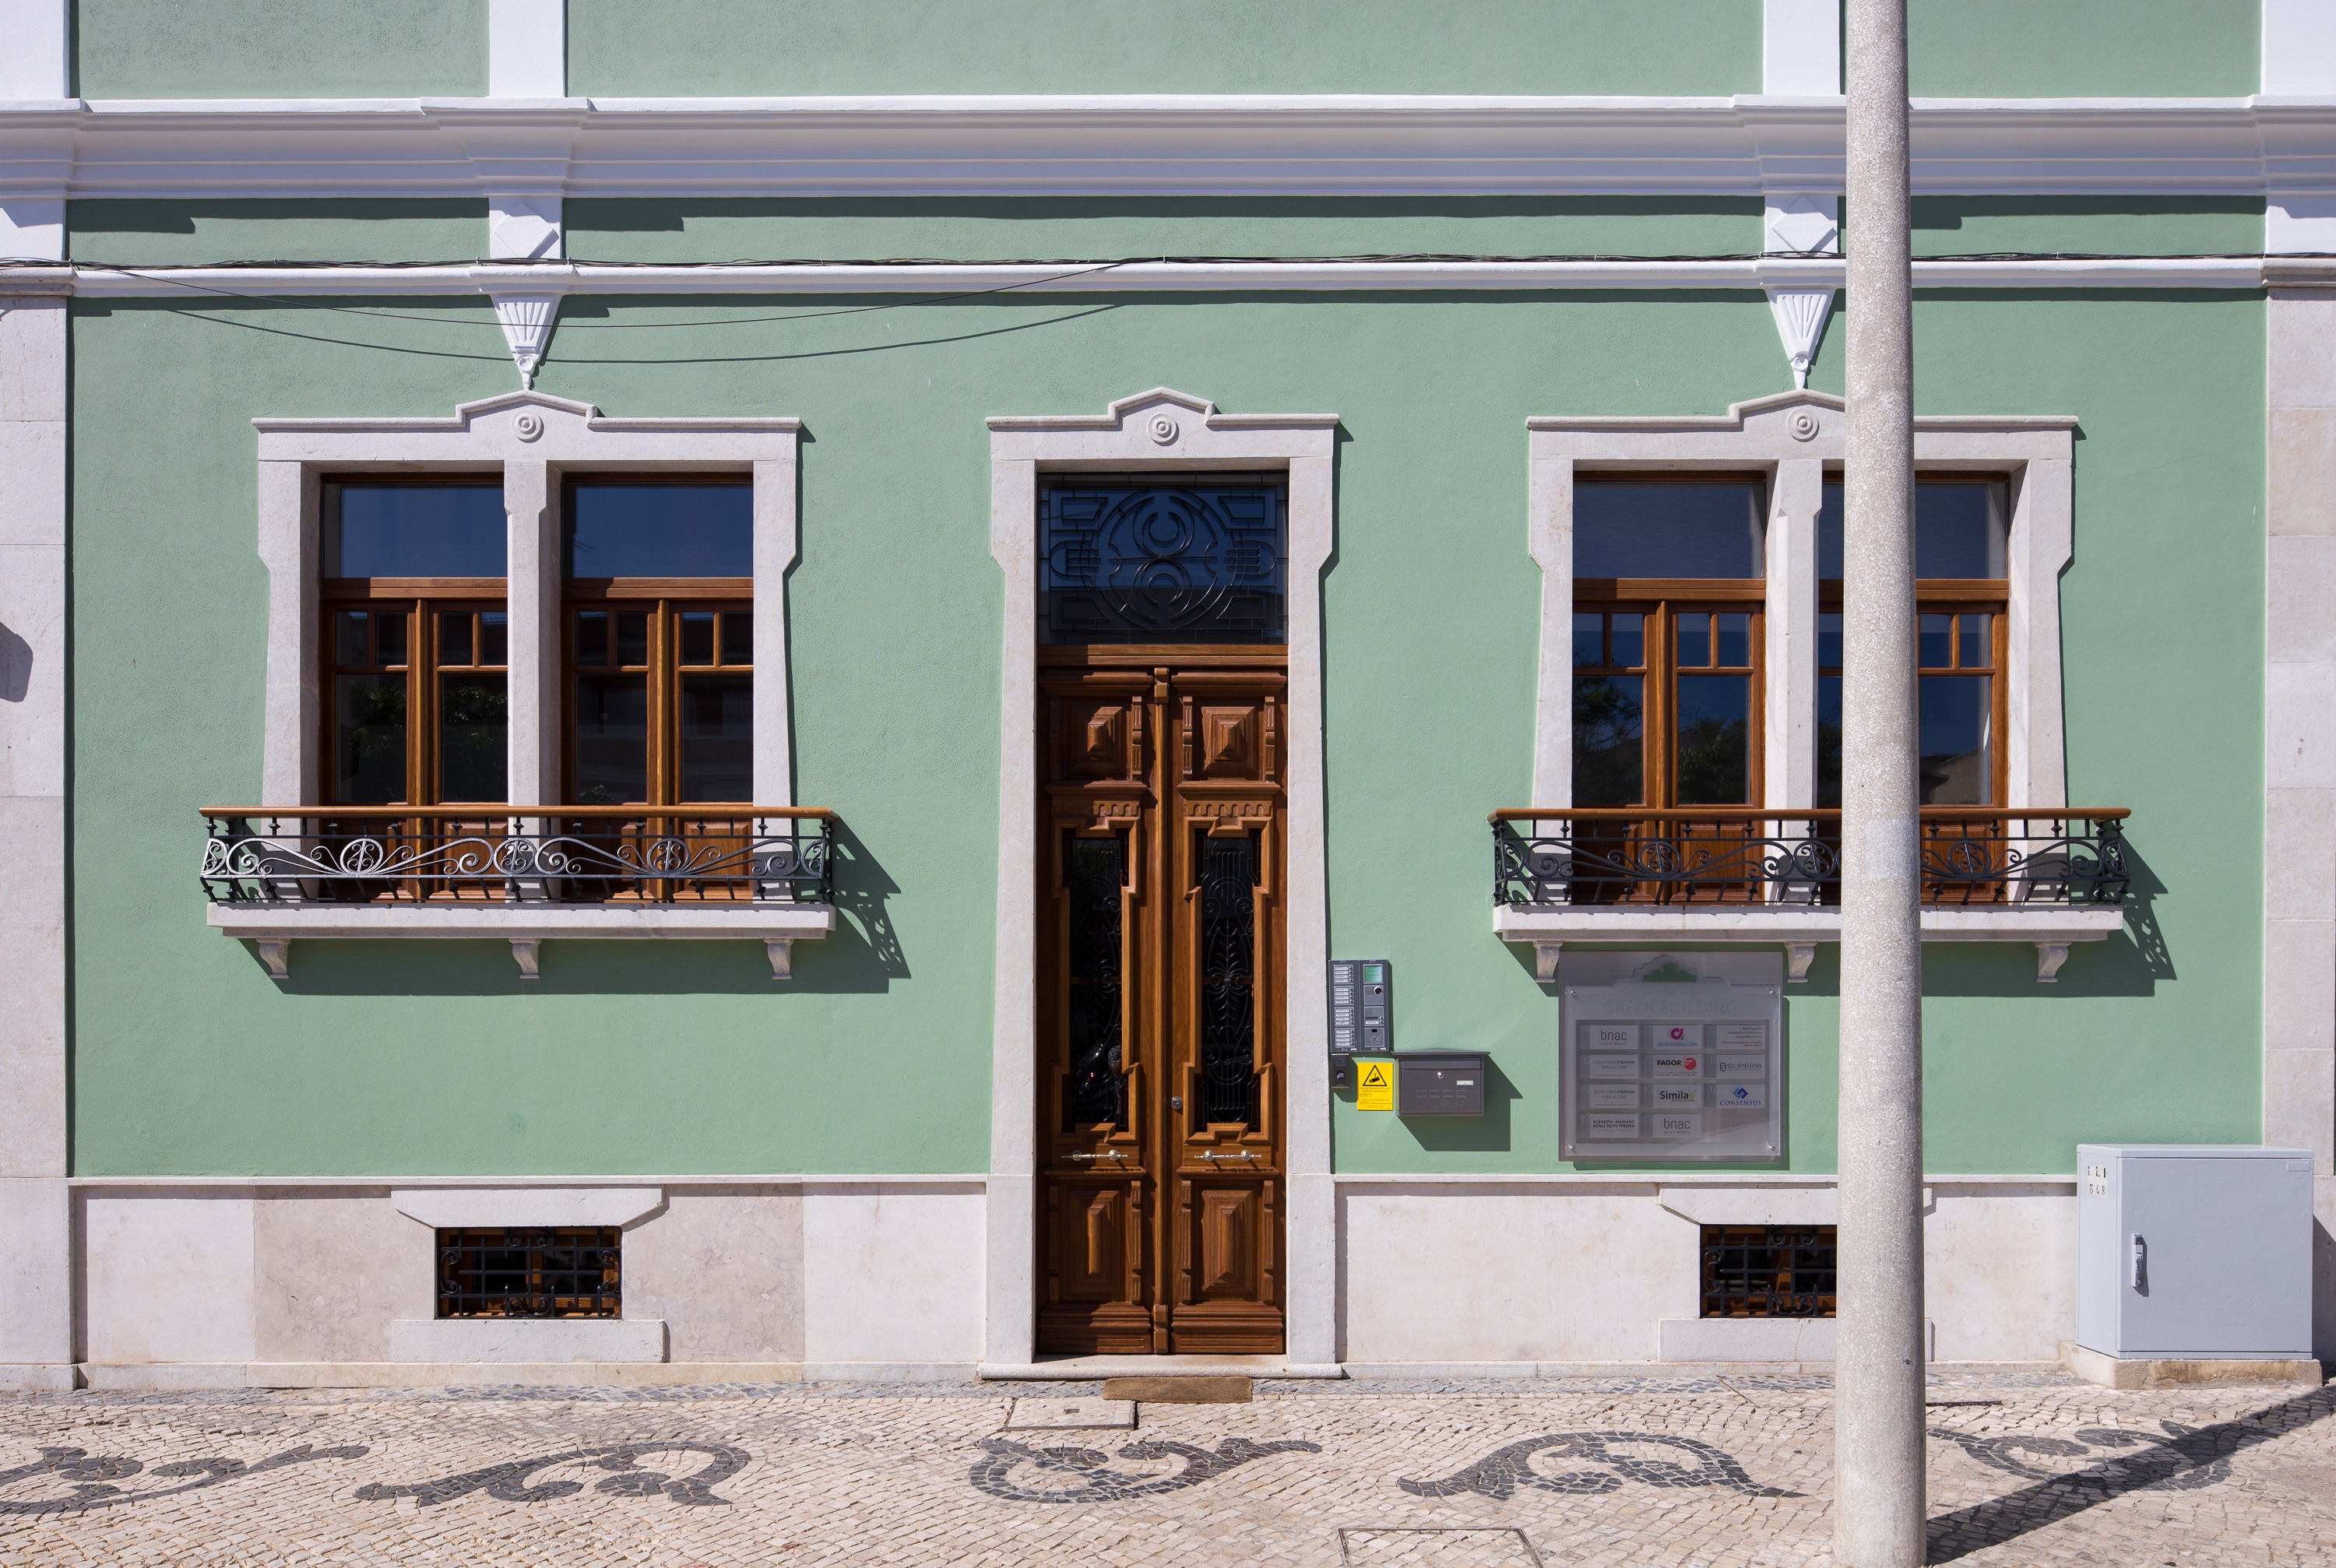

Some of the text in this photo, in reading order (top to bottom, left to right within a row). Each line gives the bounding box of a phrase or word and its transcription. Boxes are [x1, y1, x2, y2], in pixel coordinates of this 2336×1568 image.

[1603, 1001, 1737, 1014] GREEN BUILDING
[1600, 1029, 1627, 1041] bnac
[1663, 1118, 1690, 1130] bnac
